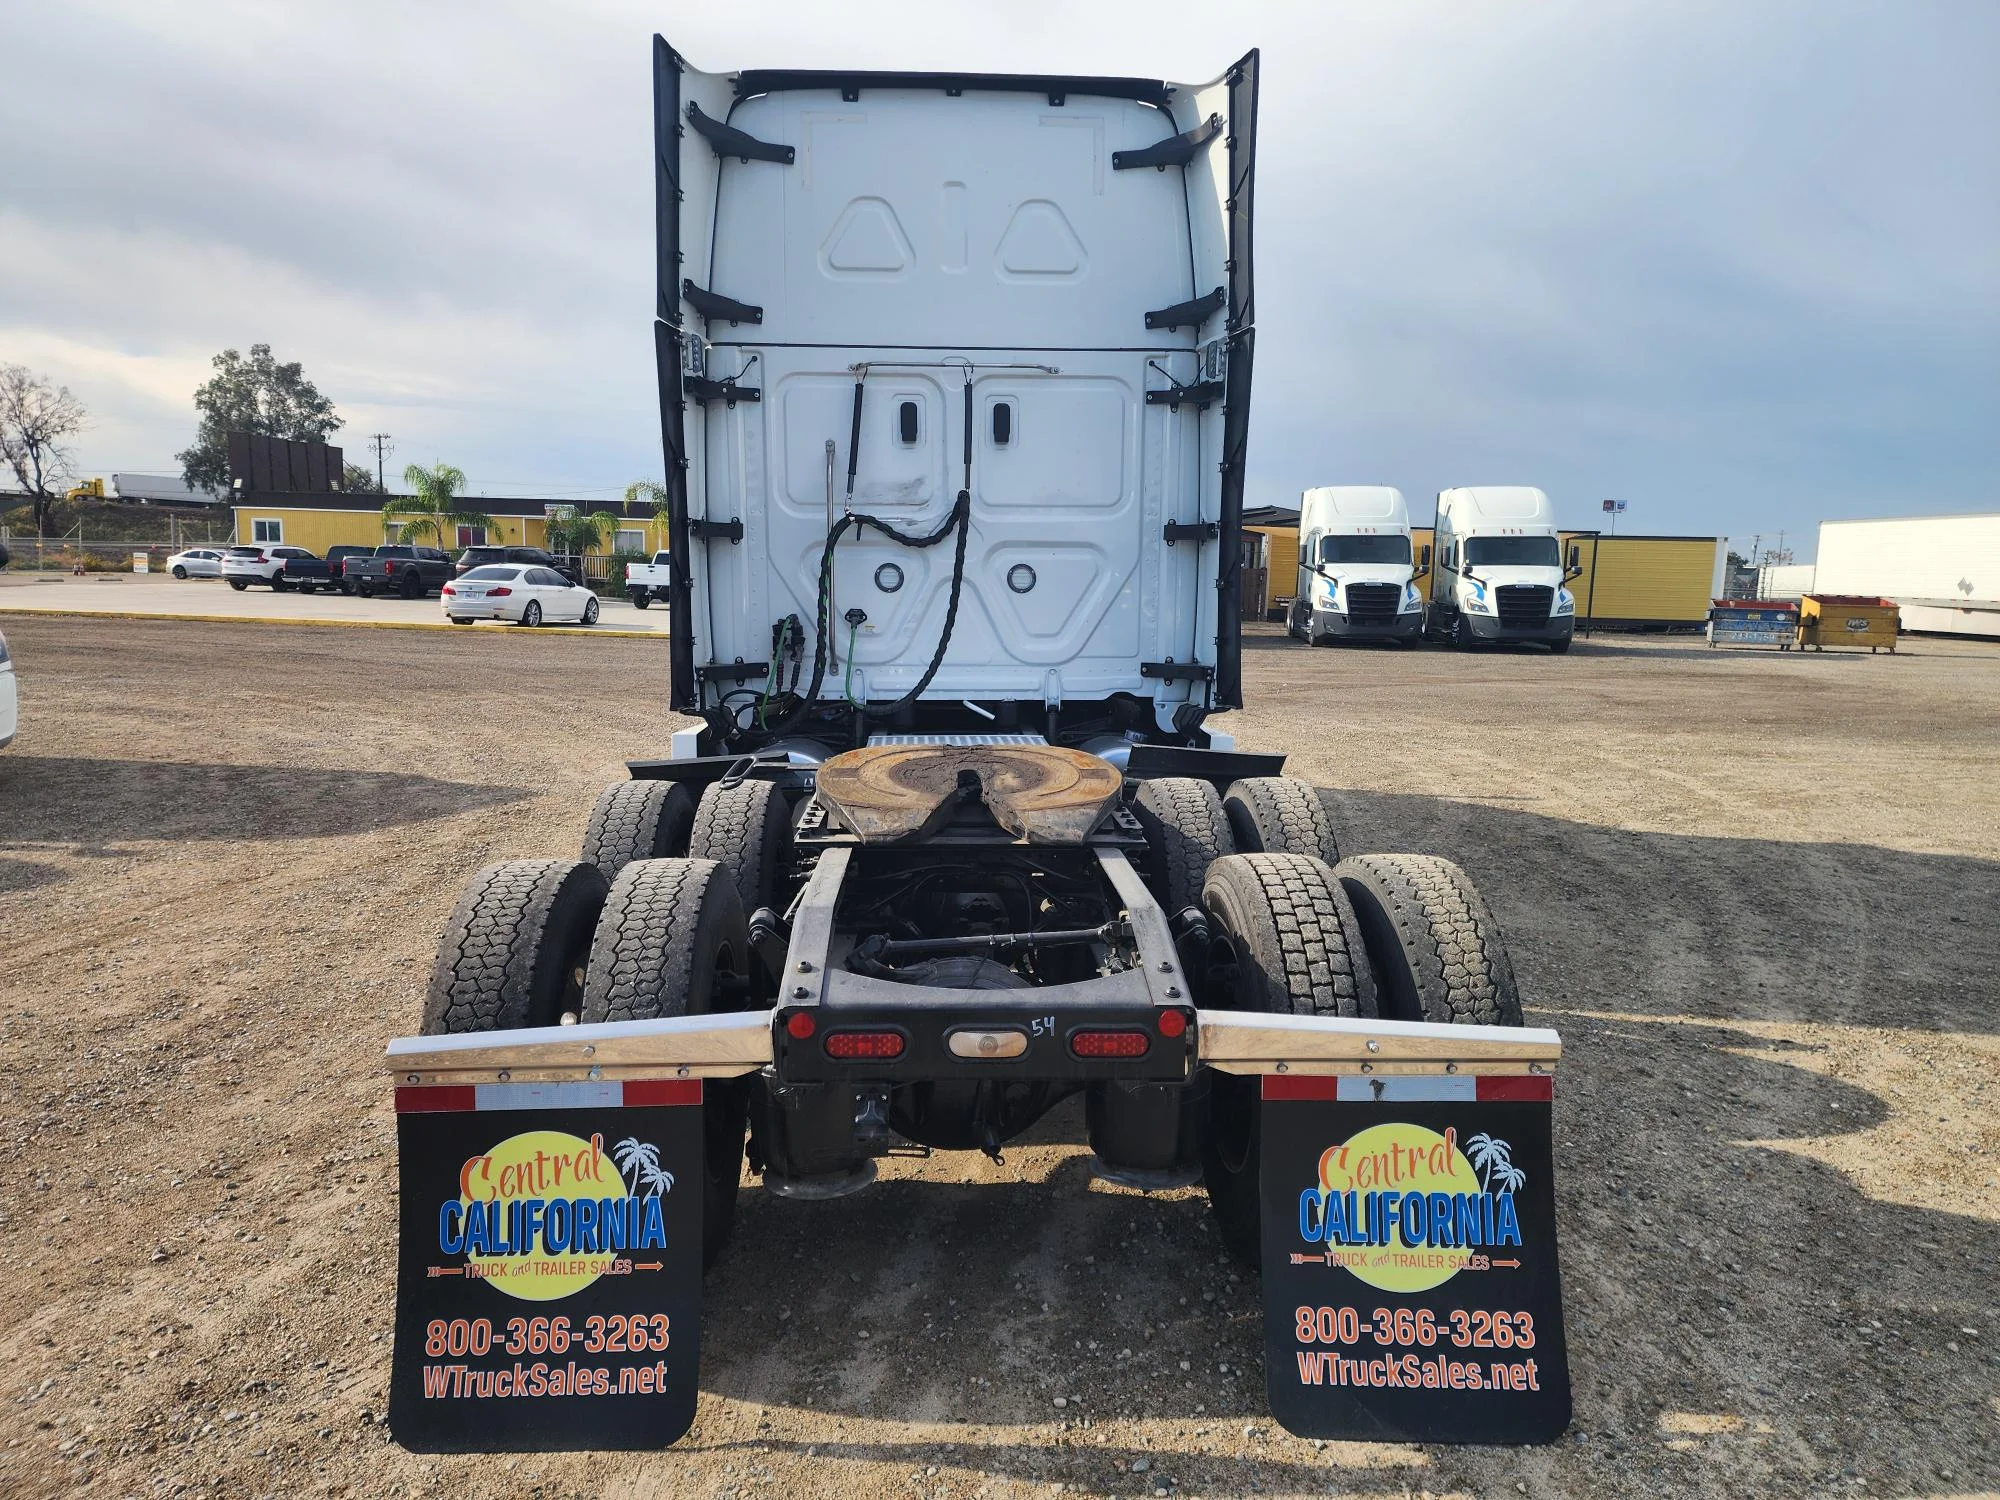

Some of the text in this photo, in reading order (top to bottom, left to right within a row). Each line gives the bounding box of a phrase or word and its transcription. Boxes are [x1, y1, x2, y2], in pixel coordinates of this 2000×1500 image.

[1031, 1016, 1055, 1037] 54
[459, 1132, 605, 1204] Central
[1317, 1126, 1458, 1195] Central
[439, 1196, 667, 1254] CALIFORNIA
[1299, 1189, 1522, 1246] CALIFORNIA
[464, 1259, 633, 1278] TRUCK and TRAILER SALES
[1324, 1252, 1368, 1267] TRUCK
[1392, 1253, 1444, 1269] TRAILER
[1448, 1255, 1490, 1270] SALES
[425, 1313, 670, 1357] 800-366-3263
[1295, 1306, 1536, 1349] 800-366-3263
[424, 1361, 667, 1398] WTruckSales.net
[1296, 1352, 1540, 1392] WTruckSales.net
